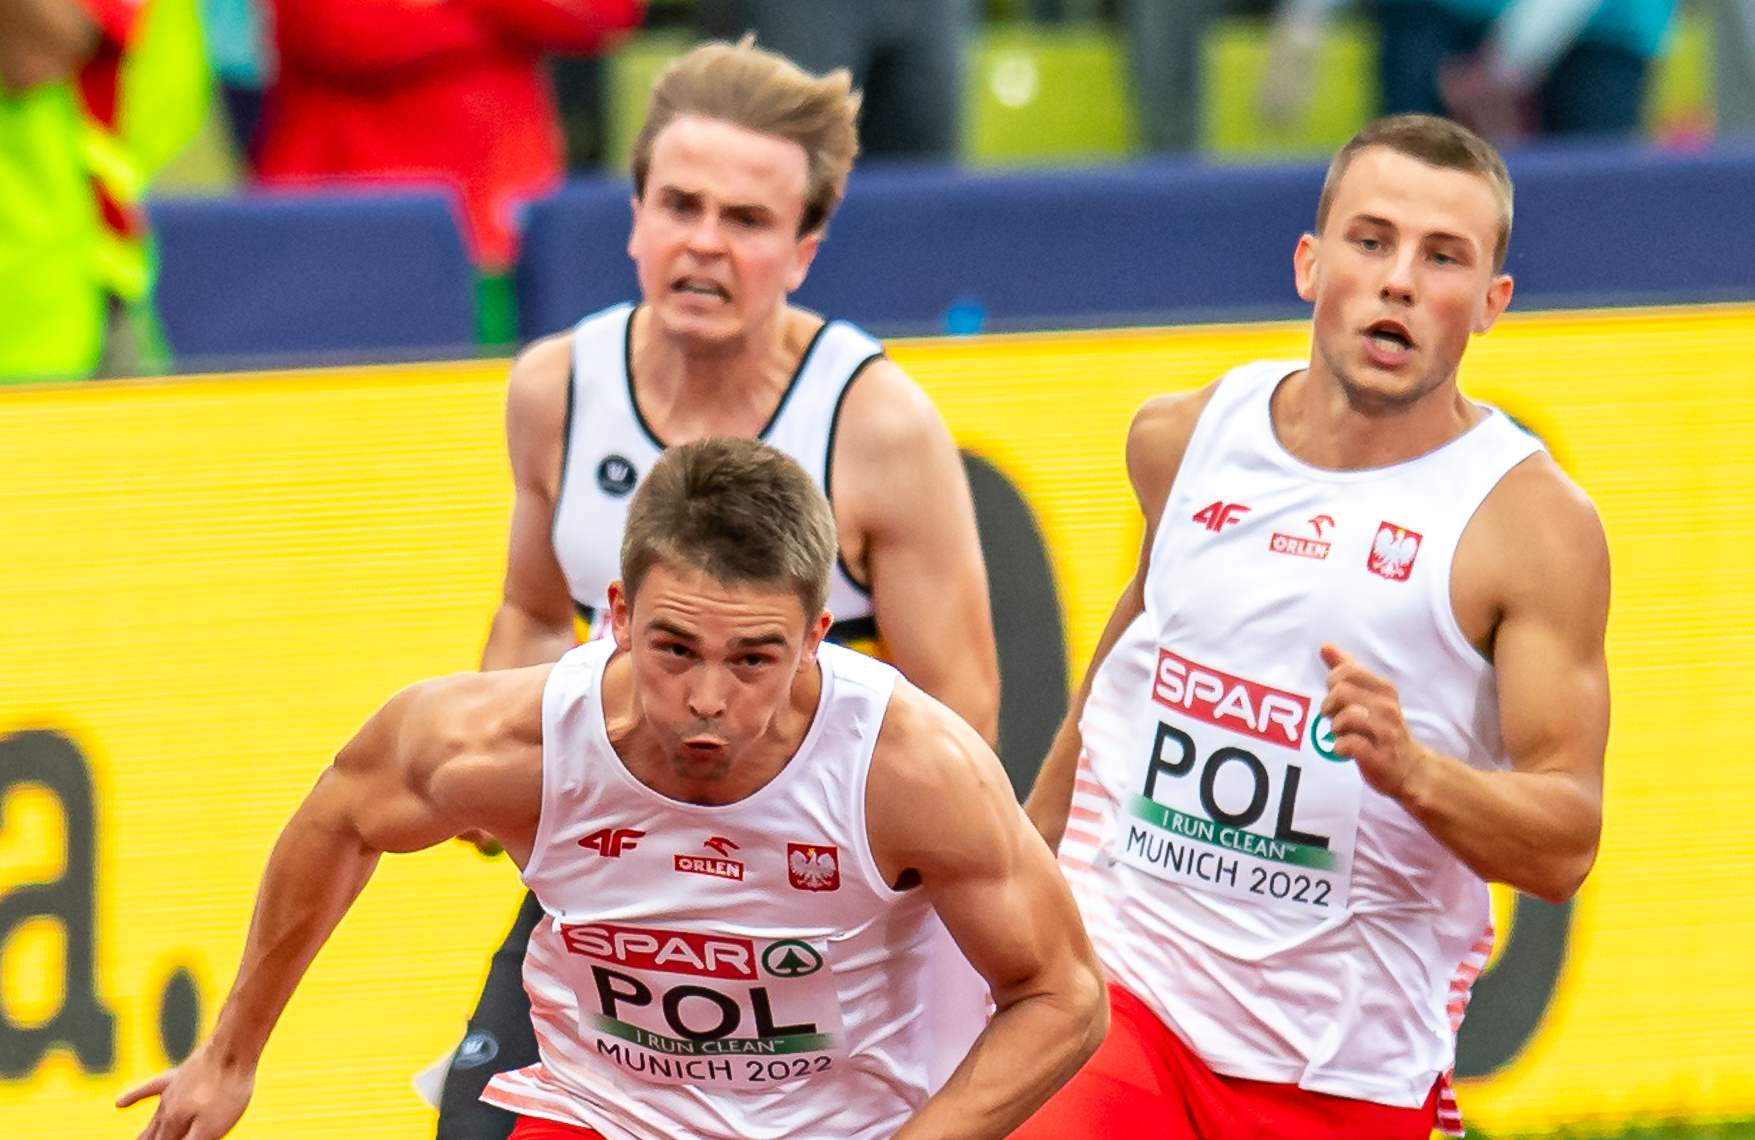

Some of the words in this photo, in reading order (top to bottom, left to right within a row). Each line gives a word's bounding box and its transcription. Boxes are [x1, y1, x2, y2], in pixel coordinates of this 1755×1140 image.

[1192, 500, 1252, 533] 4F
[1273, 535, 1327, 557] ORLEN
[1156, 656, 1307, 742] SPAR
[1143, 720, 1330, 850] POL
[577, 828, 647, 858] 4F
[1171, 814, 1214, 842] RUN
[678, 858, 741, 878] ORLEN
[1126, 825, 1239, 888] MUNICH
[1249, 866, 1332, 907] 2022
[567, 927, 752, 975] SPAR
[590, 964, 818, 1041] POL
[596, 1038, 733, 1081] MUNICH
[745, 1055, 833, 1082] 2022
[648, 1033, 694, 1053] RUN
